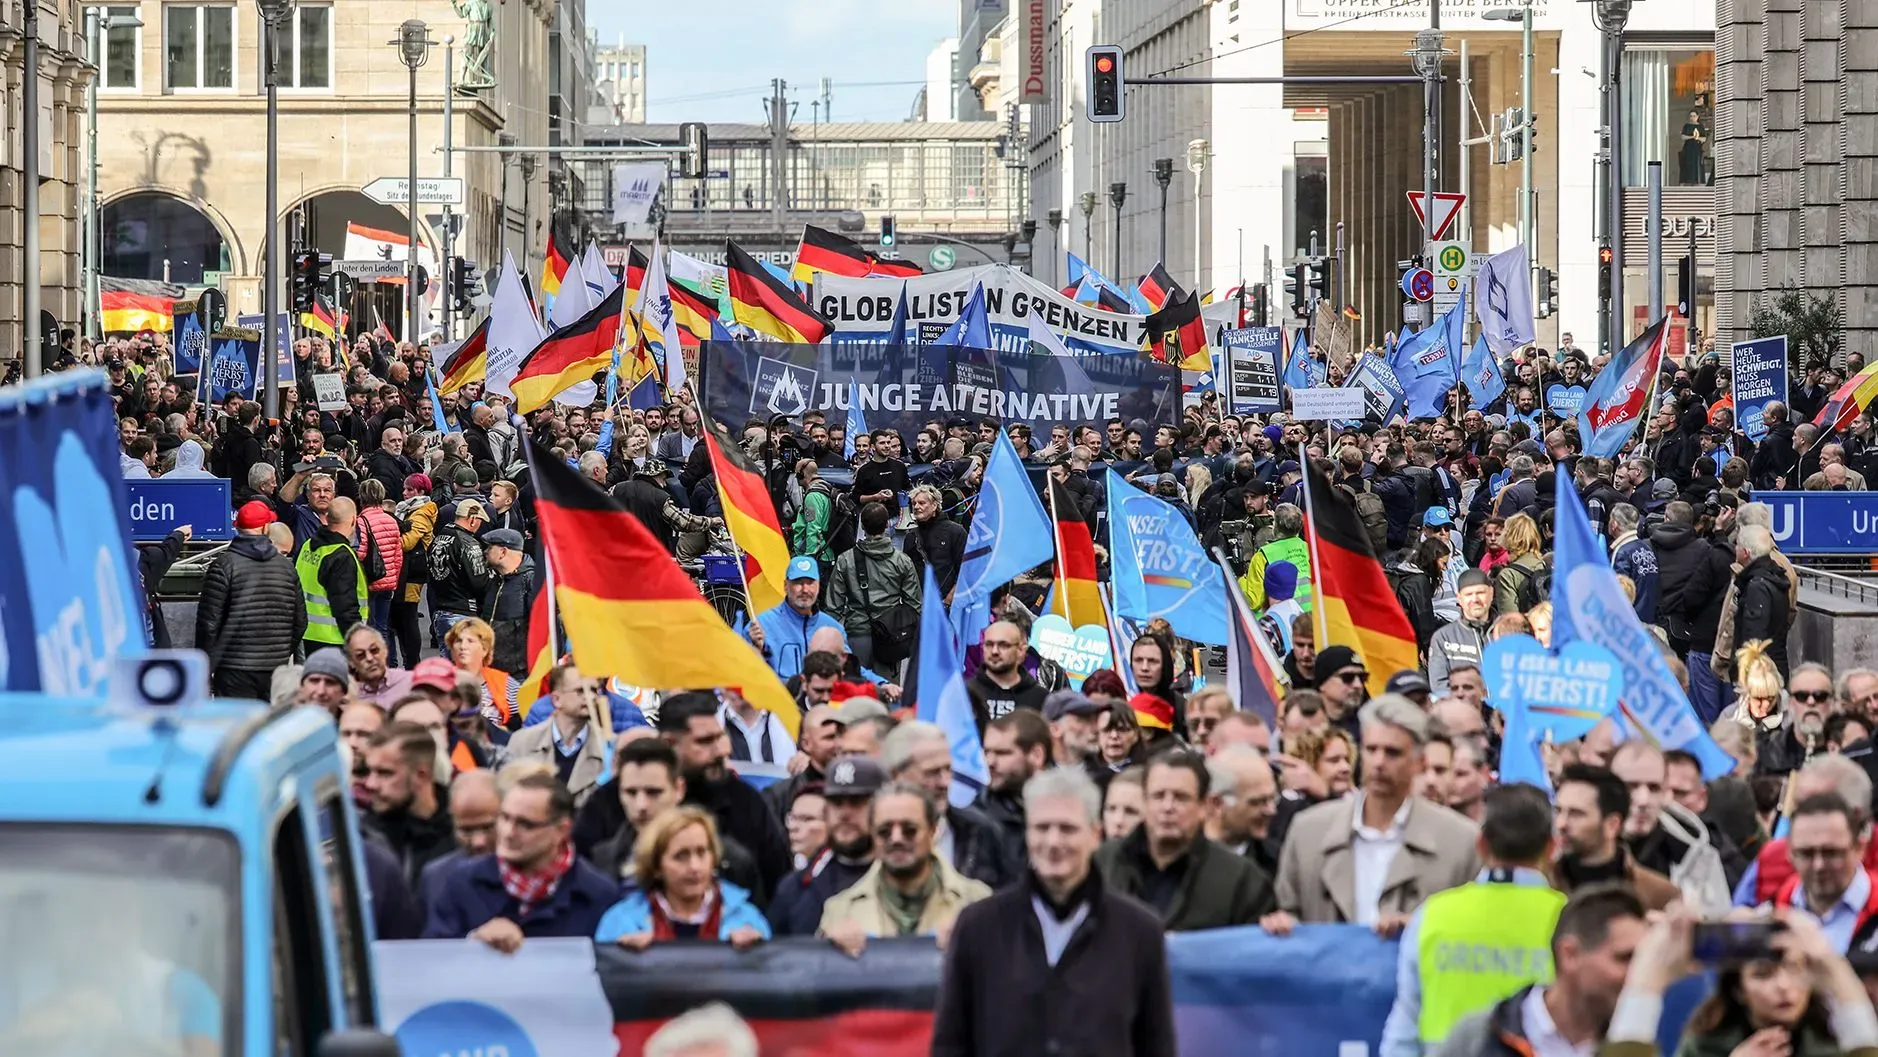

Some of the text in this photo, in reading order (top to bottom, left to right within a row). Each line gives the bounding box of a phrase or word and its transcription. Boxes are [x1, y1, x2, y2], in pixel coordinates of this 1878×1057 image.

[1025, 0, 1043, 95] Dussman
[398, 181, 441, 191] Restag/
[387, 192, 399, 200] Sitz
[932, 246, 954, 268] S
[1446, 251, 1459, 266] H
[337, 264, 399, 273] Unter den Linden
[821, 288, 1004, 322] GLOBLISTN
[1012, 291, 1128, 343] GRENZEN
[1228, 331, 1279, 345] TANKSTELLE
[1247, 340, 1276, 349] AUSSEHEN
[1735, 347, 1754, 357] WER
[214, 359, 246, 369] HEISSE
[1736, 354, 1762, 366] HEUTE
[1736, 359, 1782, 374] SCHWEIGT,
[211, 367, 249, 381] HERBST
[1255, 363, 1274, 373] 1,36
[213, 378, 246, 390] IST DA
[1257, 375, 1276, 385] 1,11
[1737, 371, 1758, 383] MUSS
[1737, 378, 1771, 391] MORGEN
[819, 383, 922, 411] JUNGE
[1260, 388, 1277, 397] 1,19
[1737, 386, 1776, 401] FRIEREN.
[1746, 411, 1763, 423] UNSE
[130, 496, 175, 521] den
[1766, 504, 1794, 541] U
[1077, 637, 1109, 656] LAND
[1564, 657, 1612, 681] LAND
[986, 699, 1016, 720] YES
[1435, 942, 1550, 981] ORDNER
